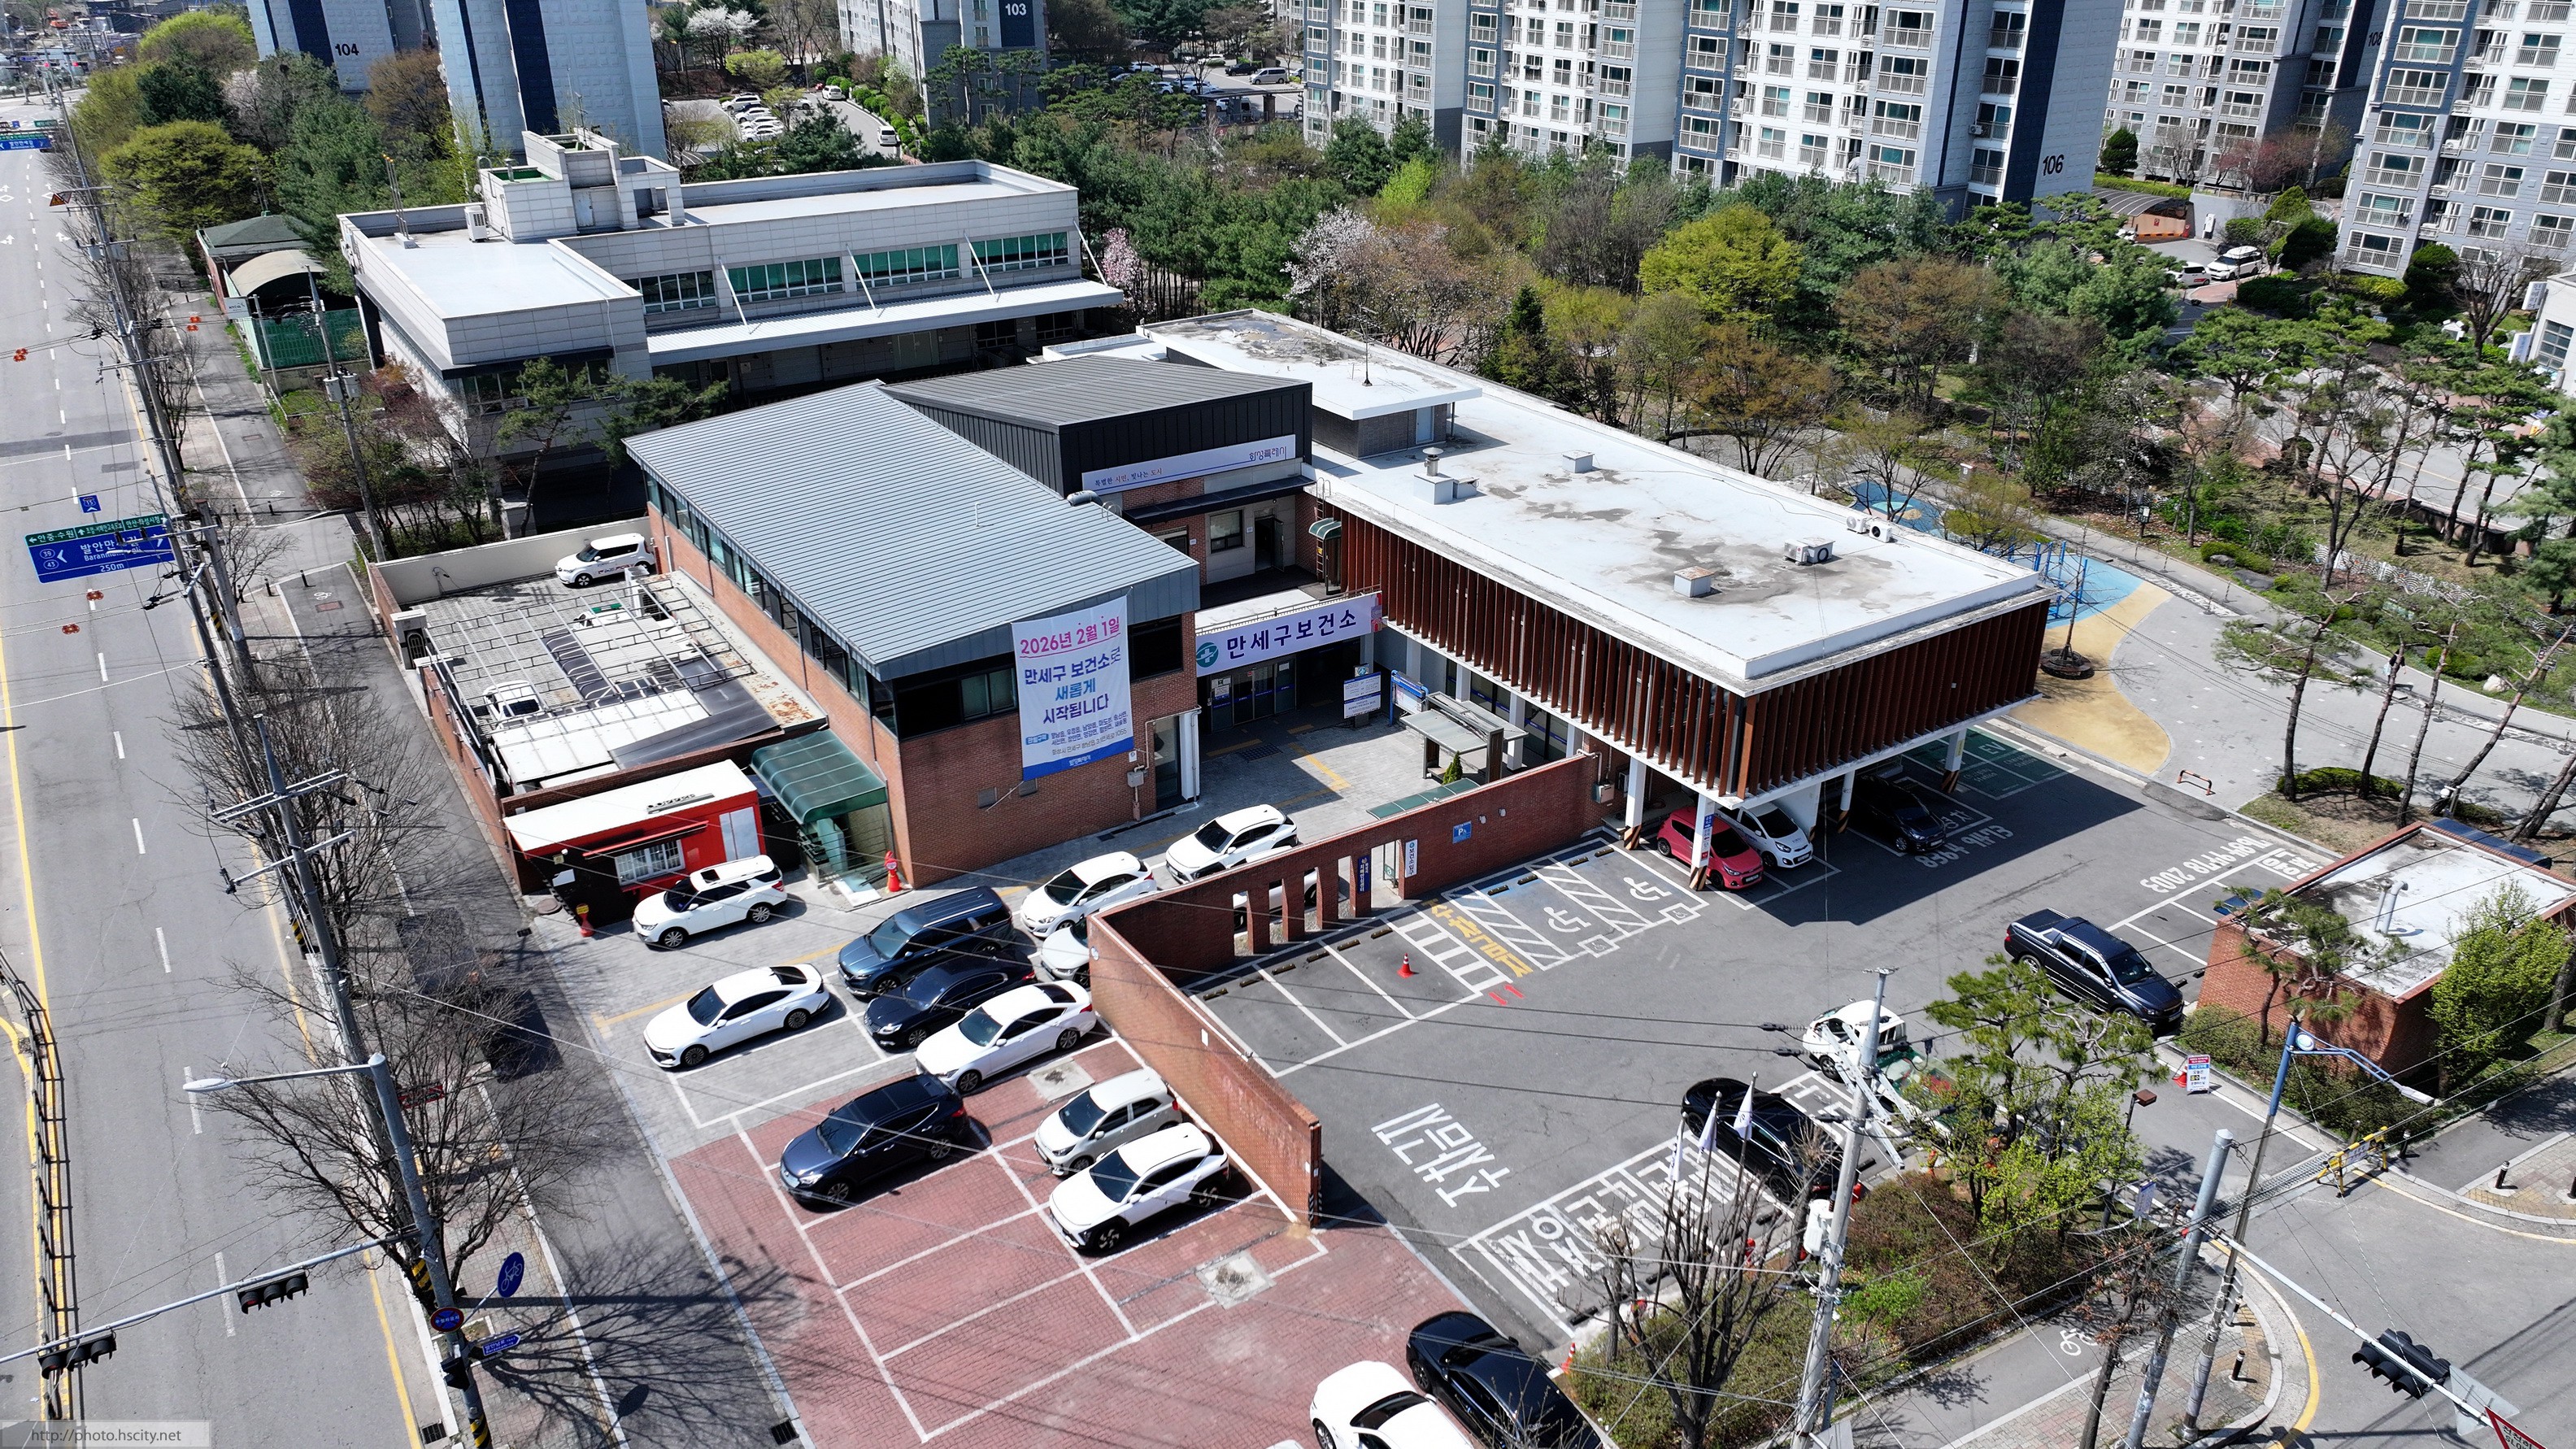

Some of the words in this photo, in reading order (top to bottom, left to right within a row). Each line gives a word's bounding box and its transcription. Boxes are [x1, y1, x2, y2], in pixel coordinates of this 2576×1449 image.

[1005, 3, 1027, 15] 103
[334, 43, 359, 56] 104
[2043, 154, 2065, 176] 106
[1094, 476, 1113, 487] 특별한
[1115, 474, 1129, 483] 시민,
[1131, 471, 1149, 480] 빛나는
[1151, 468, 1163, 476] 도시
[100, 563, 124, 572] 250m
[1020, 631, 1073, 655] 2026년
[1077, 624, 1098, 645] 2월
[1101, 616, 1120, 637] 1일
[1025, 665, 1067, 685] 만세구
[1071, 646, 1121, 678] 보건소로
[1055, 678, 1096, 701] 새롭게
[1042, 694, 1109, 724] 시작됩니다
[1978, 742, 2007, 755] EV
[2140, 867, 2196, 894] 2003
[1421, 898, 1534, 978] 주차금지
[1371, 1102, 1511, 1208] 주차금지
[2502, 1425, 2532, 1449] 천천히
